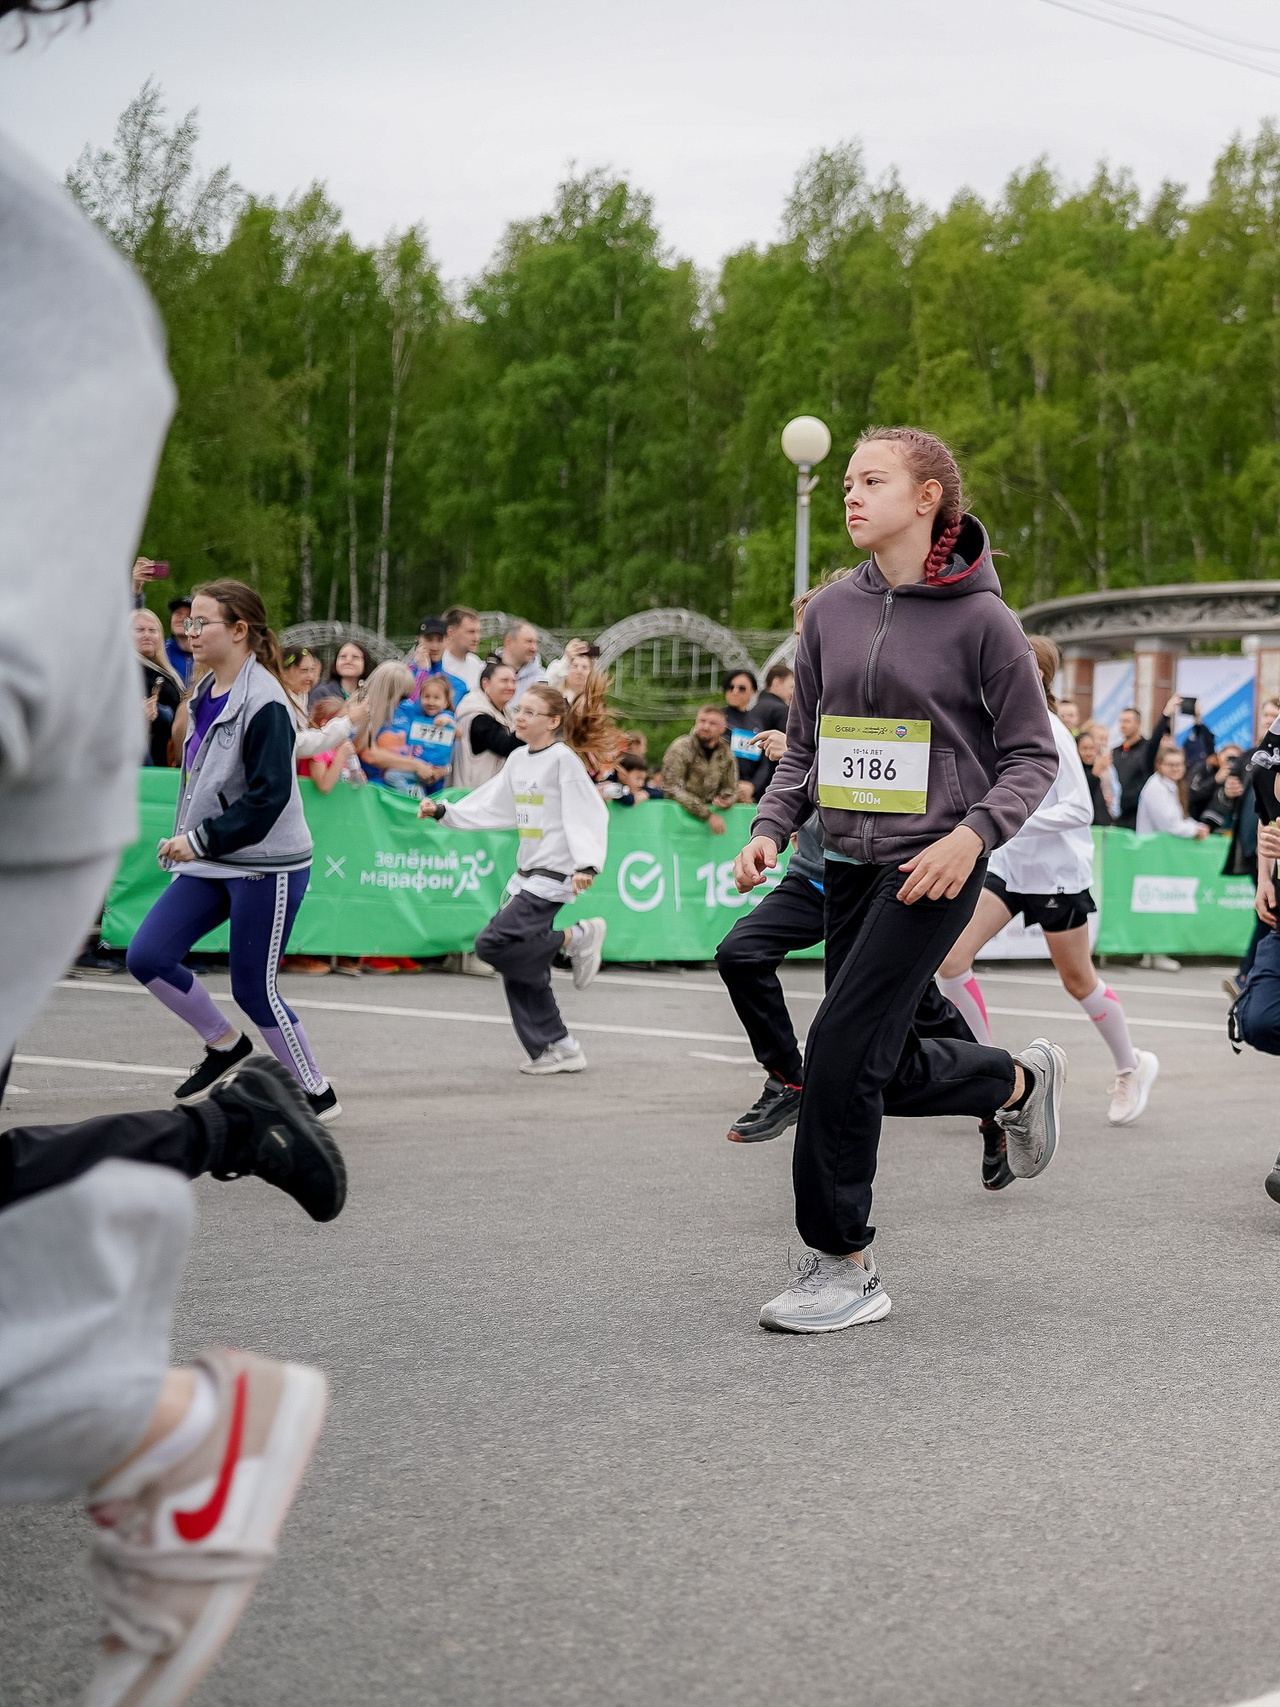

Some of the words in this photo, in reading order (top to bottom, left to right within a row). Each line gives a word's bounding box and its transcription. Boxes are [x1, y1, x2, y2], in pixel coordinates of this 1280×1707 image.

[842, 756, 897, 781] 3186
[374, 849, 460, 871] зелёный
[360, 870, 454, 893] марафон
